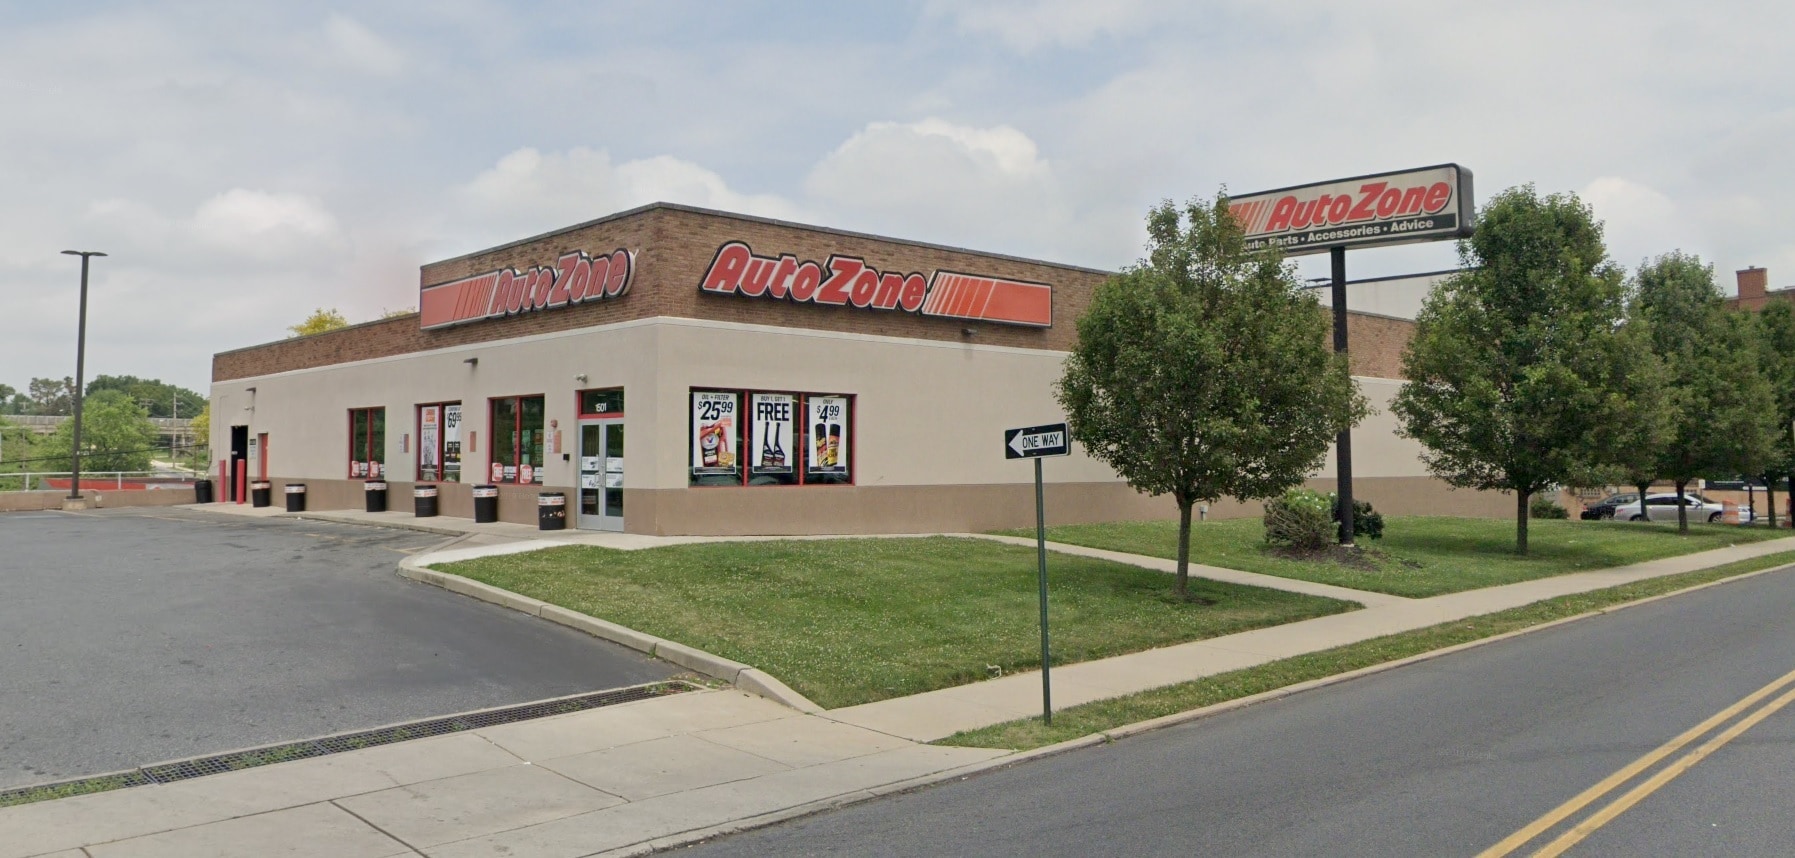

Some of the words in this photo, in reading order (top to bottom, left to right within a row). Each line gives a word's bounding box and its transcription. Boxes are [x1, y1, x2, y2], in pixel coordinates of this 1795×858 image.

[1264, 181, 1451, 232] AutoZone
[1268, 236, 1298, 247] Parts
[1307, 225, 1380, 242] Accessories
[1391, 219, 1434, 233] Advice
[488, 248, 630, 316] AutoZone
[701, 241, 928, 314] AutoZone
[757, 402, 790, 422] FREE
[1022, 435, 1040, 448] ONE
[1042, 433, 1059, 446] WAY
